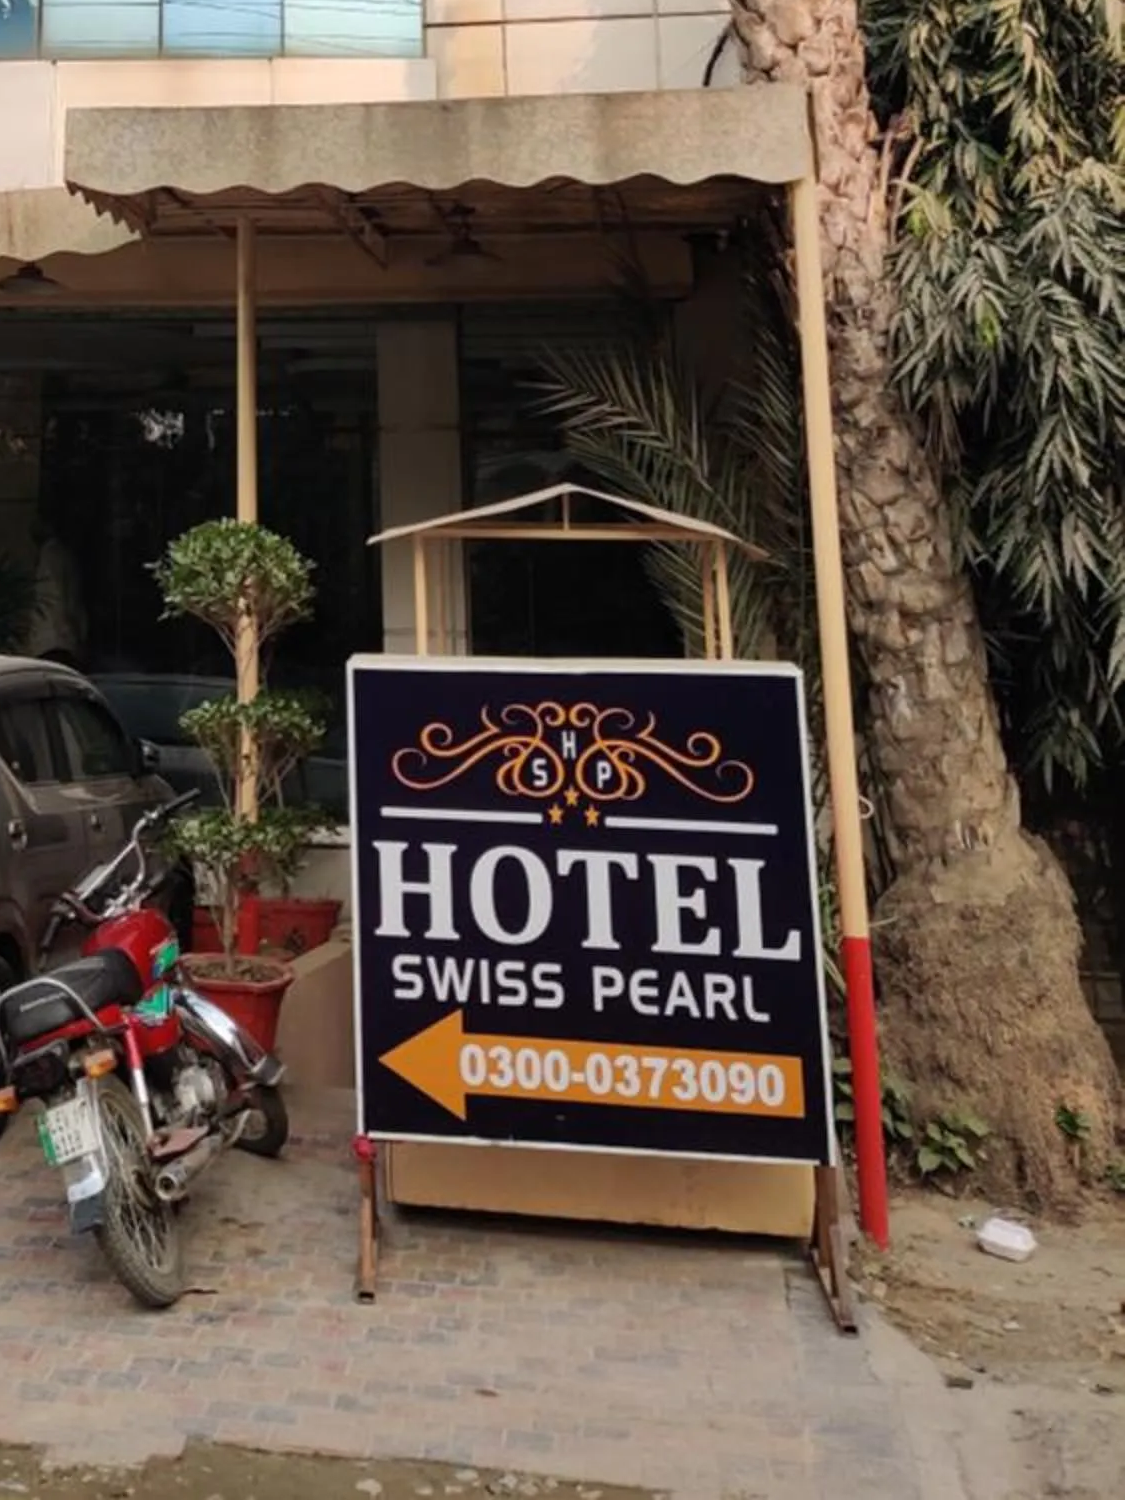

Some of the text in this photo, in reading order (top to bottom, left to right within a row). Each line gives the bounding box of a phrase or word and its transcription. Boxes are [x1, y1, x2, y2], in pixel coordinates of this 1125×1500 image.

[531, 760, 613, 789] S P
[561, 730, 577, 759] H
[372, 840, 802, 961] HOTEL
[391, 954, 771, 1023] SWISS PEARL
[458, 1043, 787, 1107] 0300-0373090
